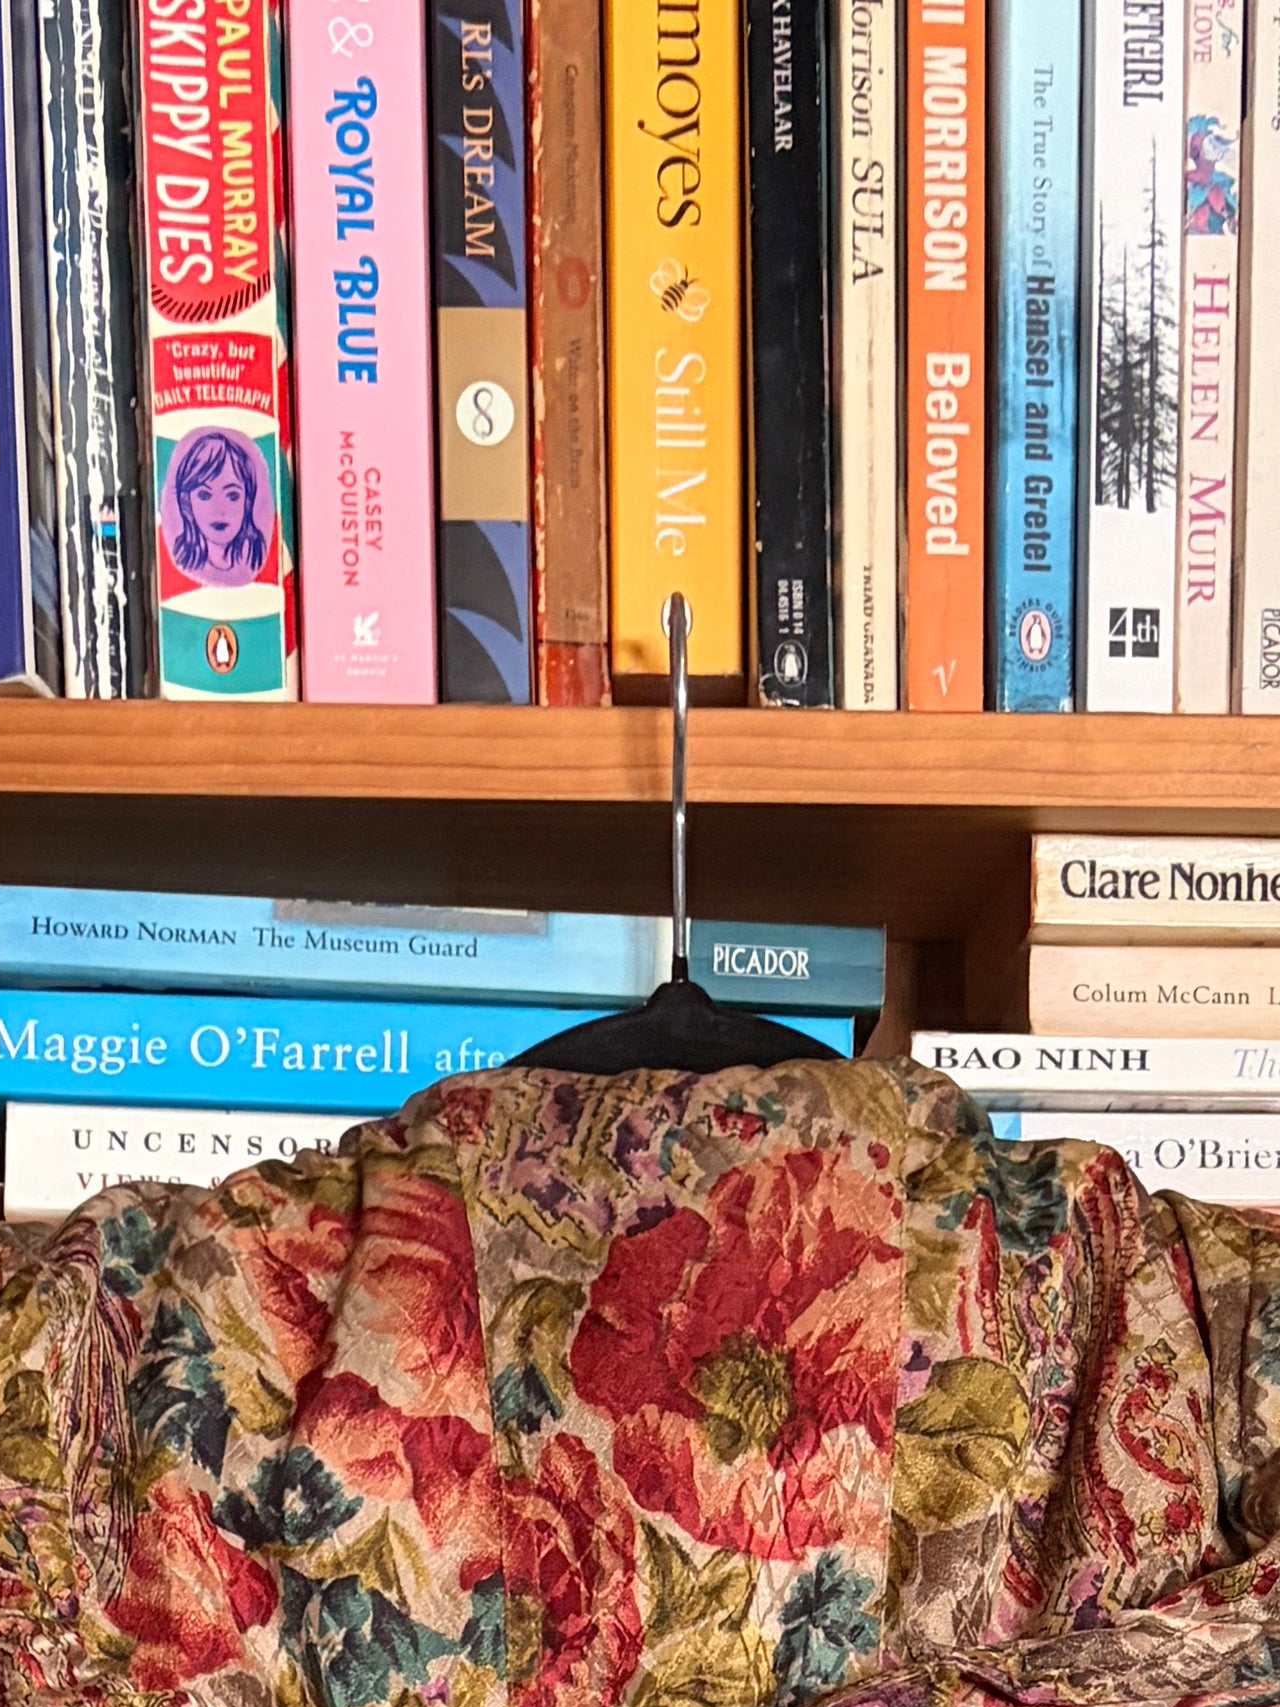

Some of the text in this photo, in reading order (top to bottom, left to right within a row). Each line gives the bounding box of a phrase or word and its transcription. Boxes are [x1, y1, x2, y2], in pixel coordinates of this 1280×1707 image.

[219, 122, 257, 282] MURRAY
[325, 76, 378, 384] ROYAL BLUE
[921, 45, 971, 556] MORRISON Beloved
[1022, 276, 1055, 572] Hansel and Gretel
[1185, 272, 1230, 606] HELEN MUIR
[364, 468, 381, 551] CASEY
[1061, 861, 1161, 902] Clare
[253, 927, 479, 961] The Museum Guard
[712, 944, 811, 980] PICADOR
[1072, 984, 1150, 1006] Colum
[1158, 984, 1251, 1006] McCann
[189, 1025, 411, 1075] O'Farrell
[932, 1045, 1151, 1073] BAO NINH
